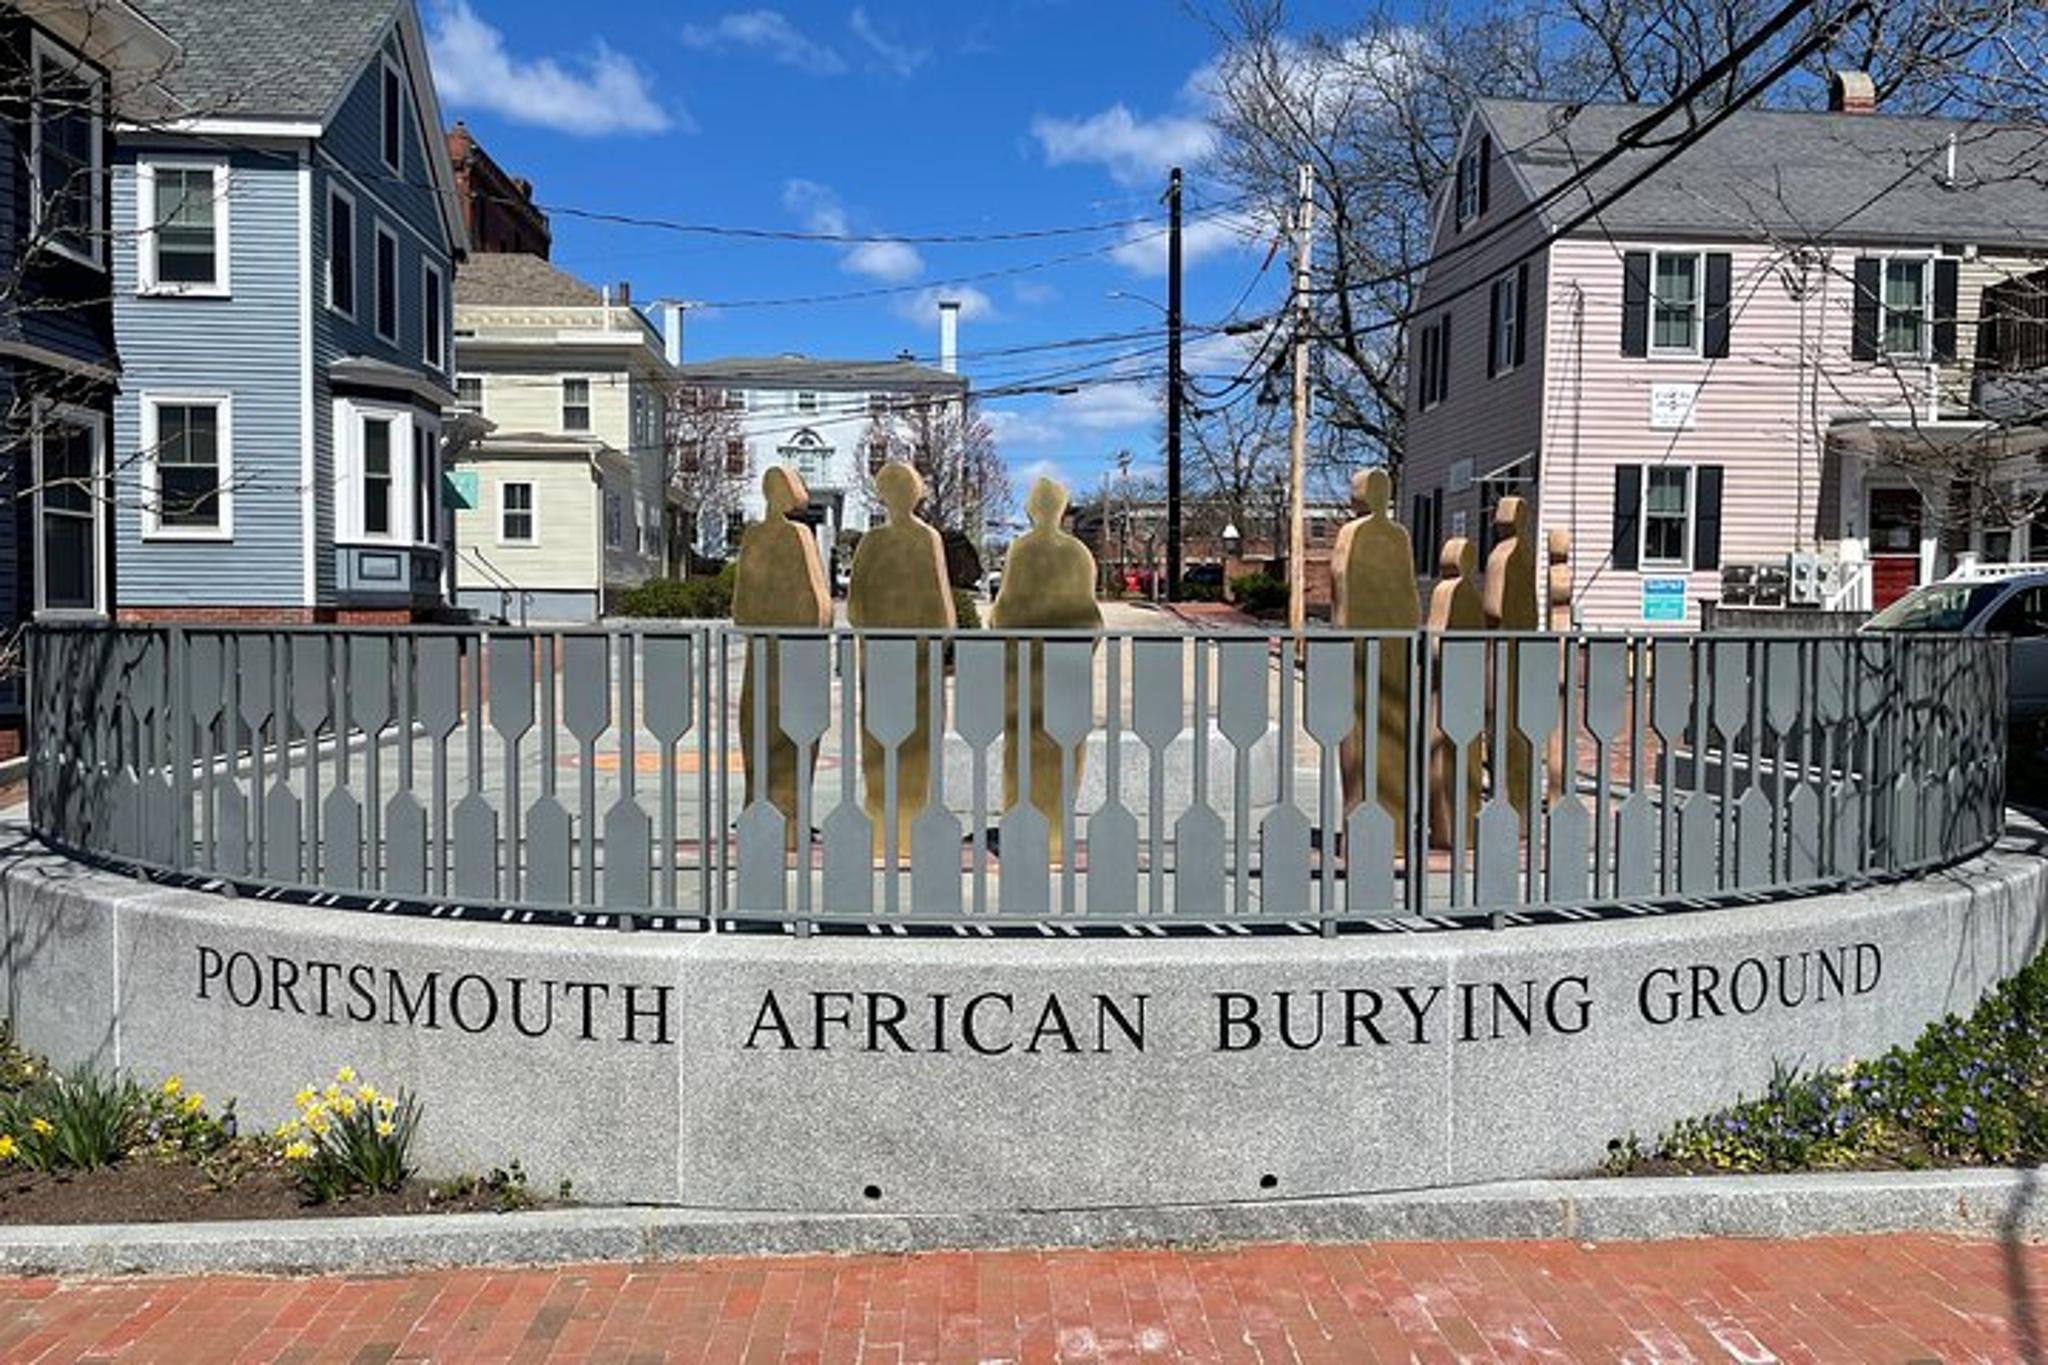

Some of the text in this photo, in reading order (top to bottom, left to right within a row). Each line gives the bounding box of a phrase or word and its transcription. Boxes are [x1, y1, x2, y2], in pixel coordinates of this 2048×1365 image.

[196, 942, 1883, 1055] PORTSMOUTH AFRICAN BURYING GROUND
